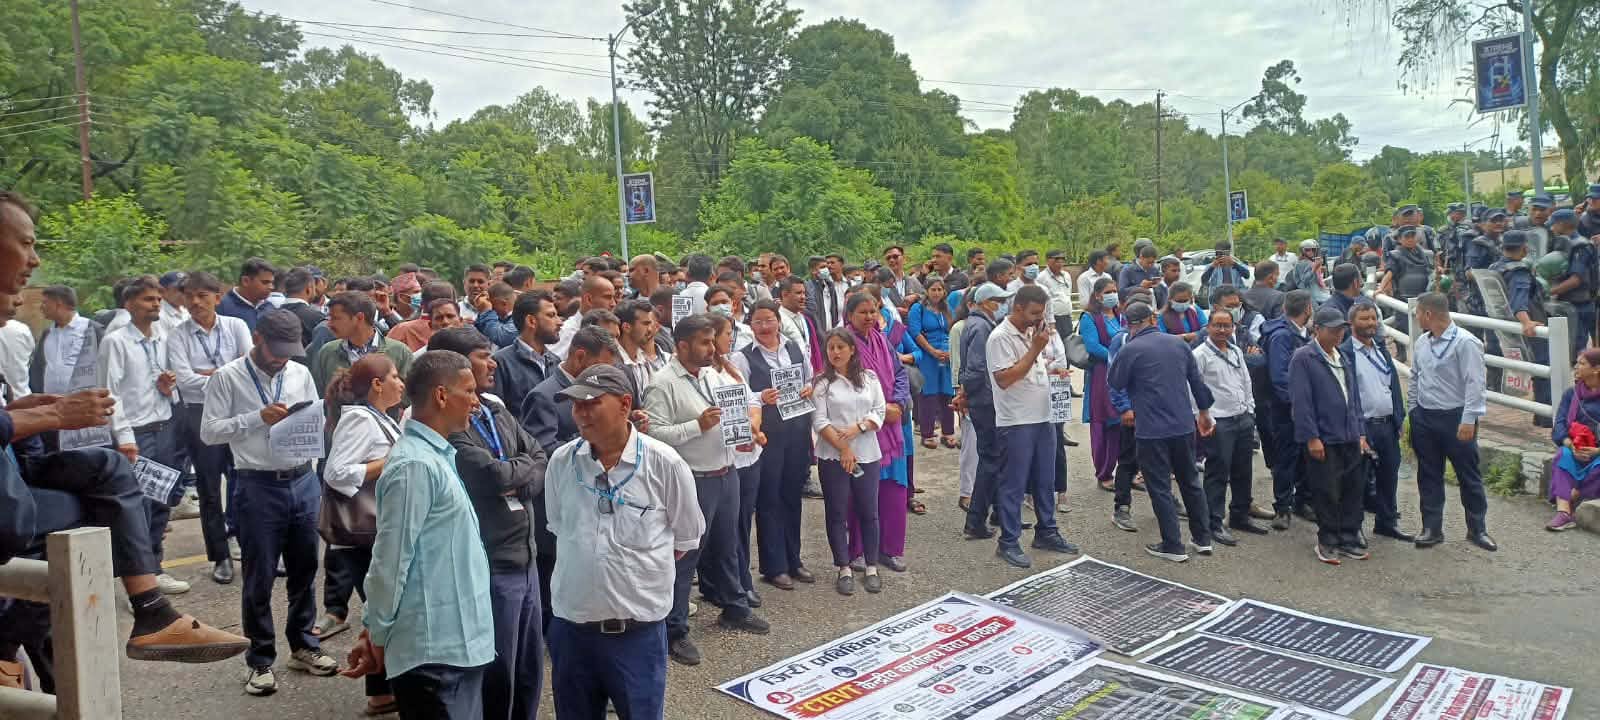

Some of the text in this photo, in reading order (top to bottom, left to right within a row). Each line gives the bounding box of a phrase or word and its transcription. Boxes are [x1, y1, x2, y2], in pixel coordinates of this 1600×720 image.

[759, 663, 811, 686] जिरी
[877, 606, 949, 638] शिक्षालय
[855, 668, 899, 690] केन्द्रीय
[894, 650, 946, 674] कार्यालय
